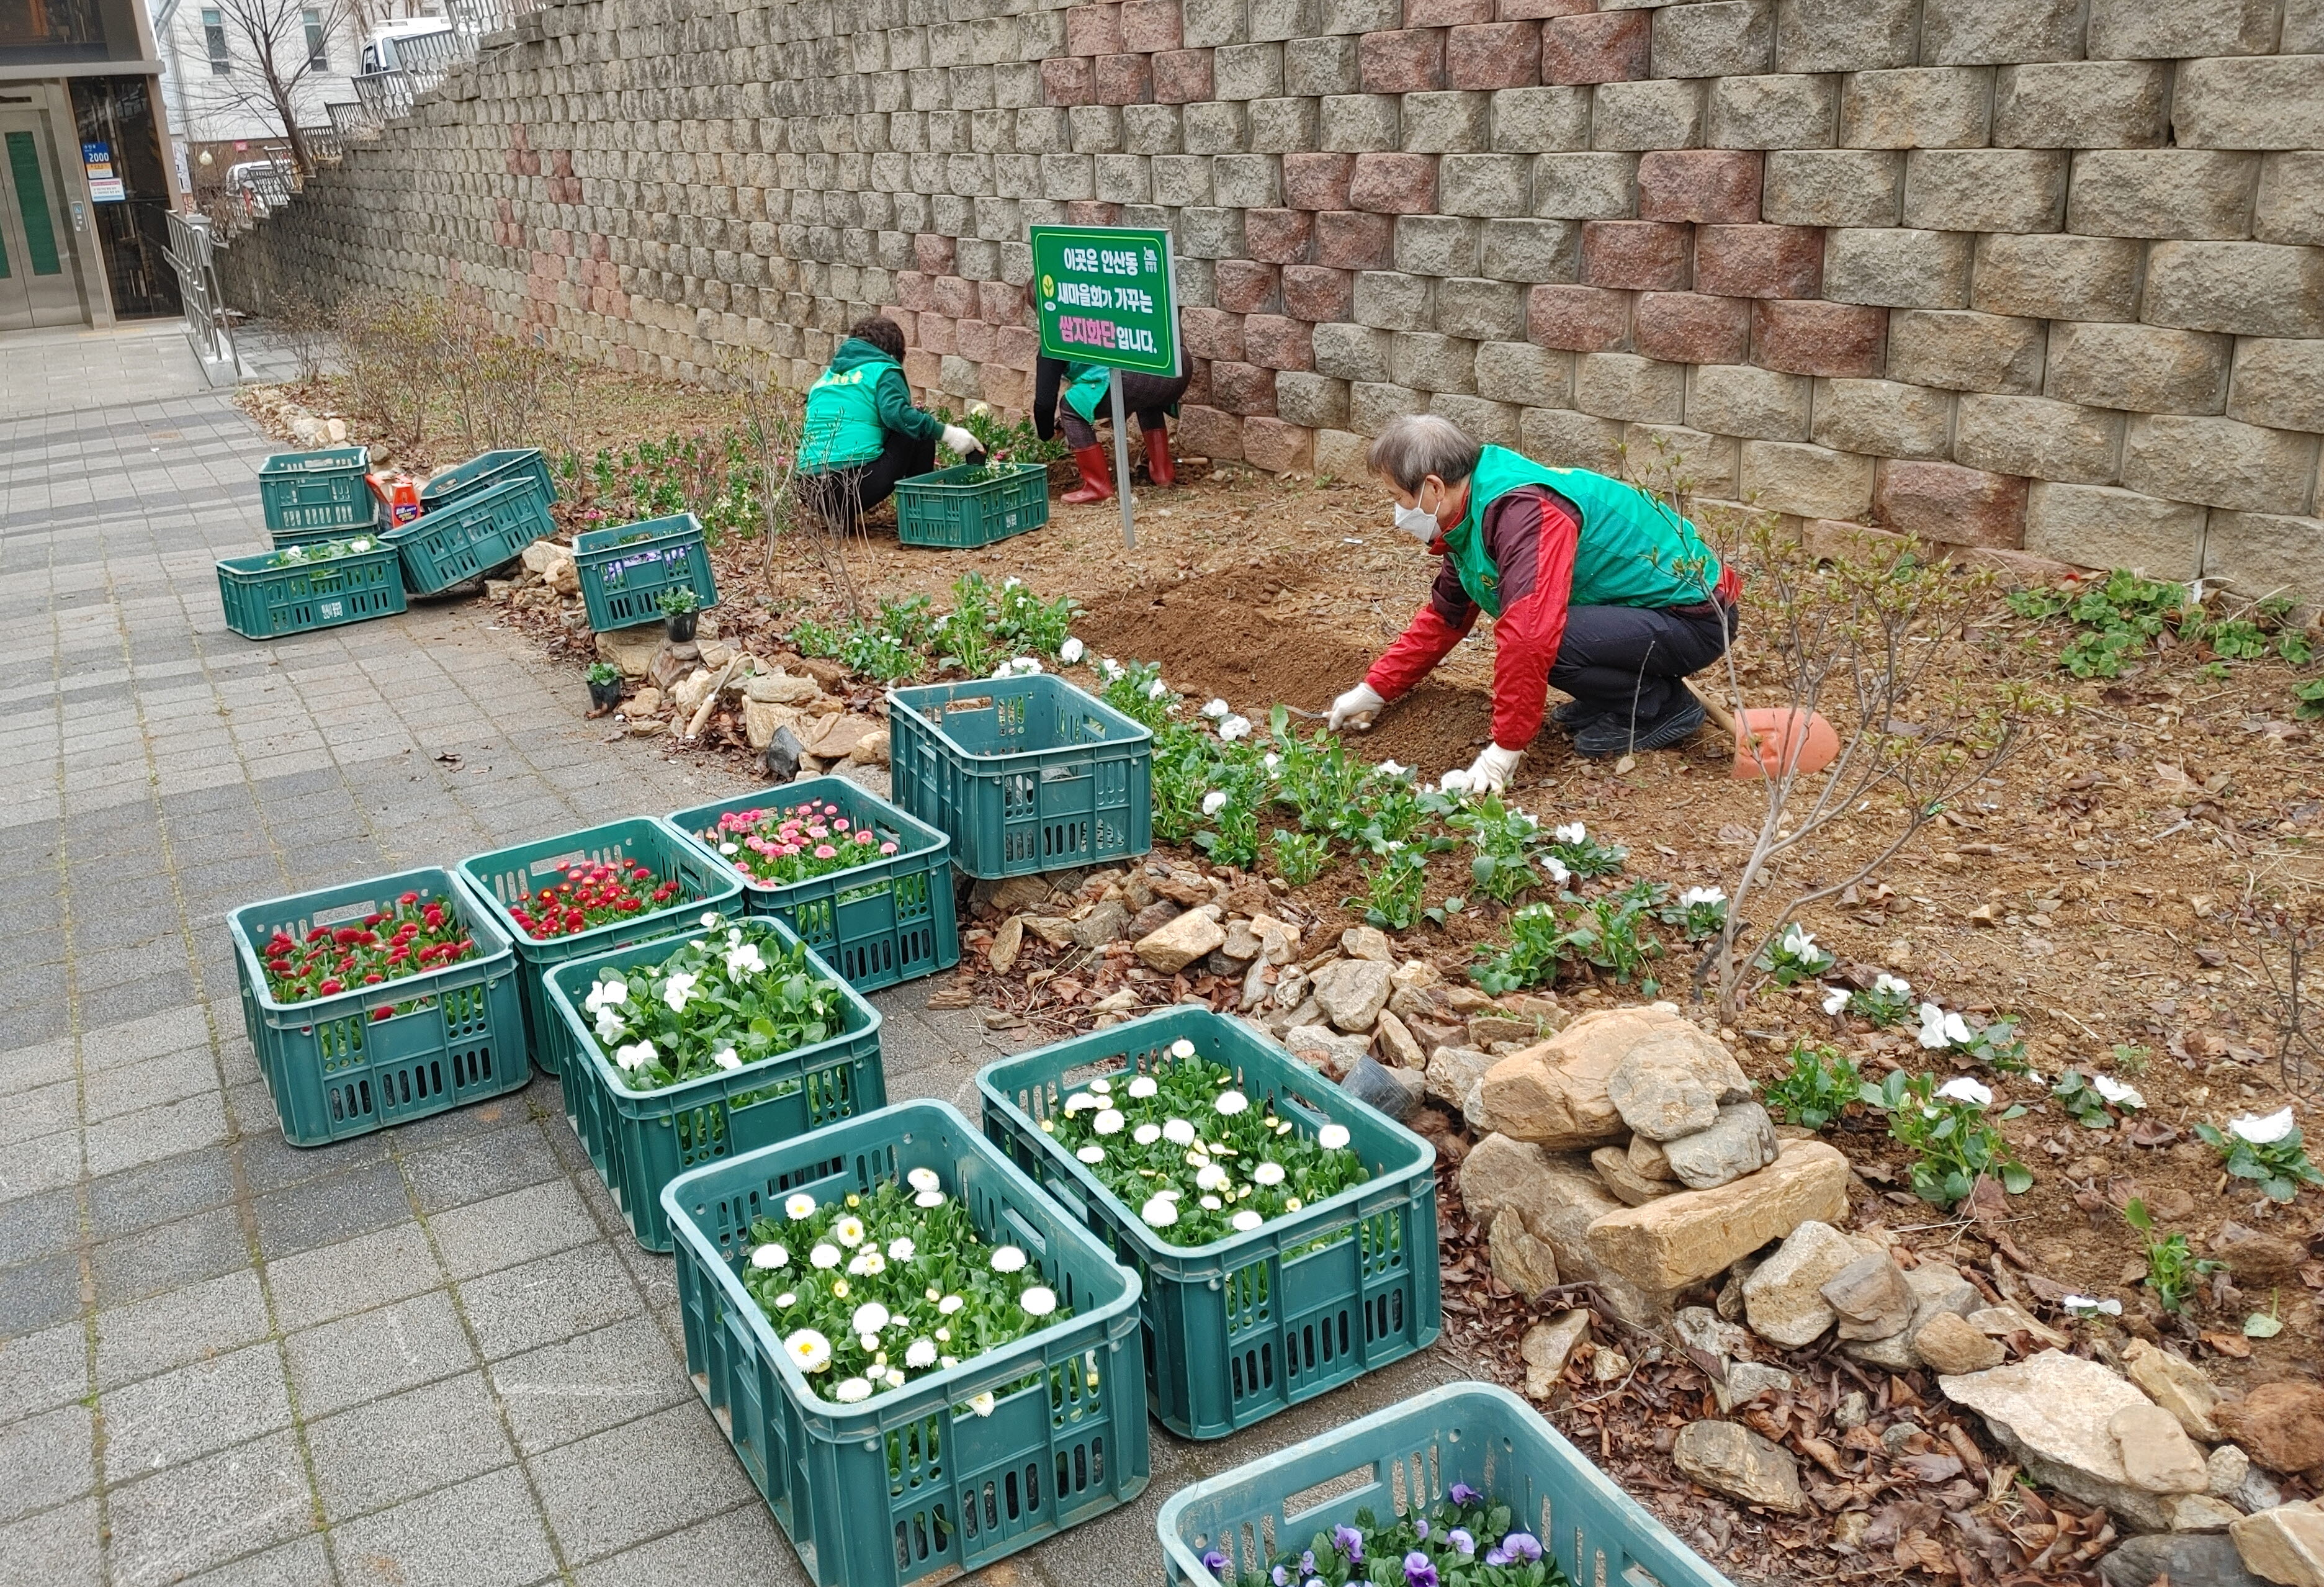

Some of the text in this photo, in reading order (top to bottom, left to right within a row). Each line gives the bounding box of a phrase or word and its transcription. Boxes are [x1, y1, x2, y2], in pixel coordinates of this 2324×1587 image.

[89, 153, 109, 162] 2000
[1064, 248, 1138, 276] 이곳은 안산동
[1057, 282, 1153, 313] 새마을회가 가꾸는
